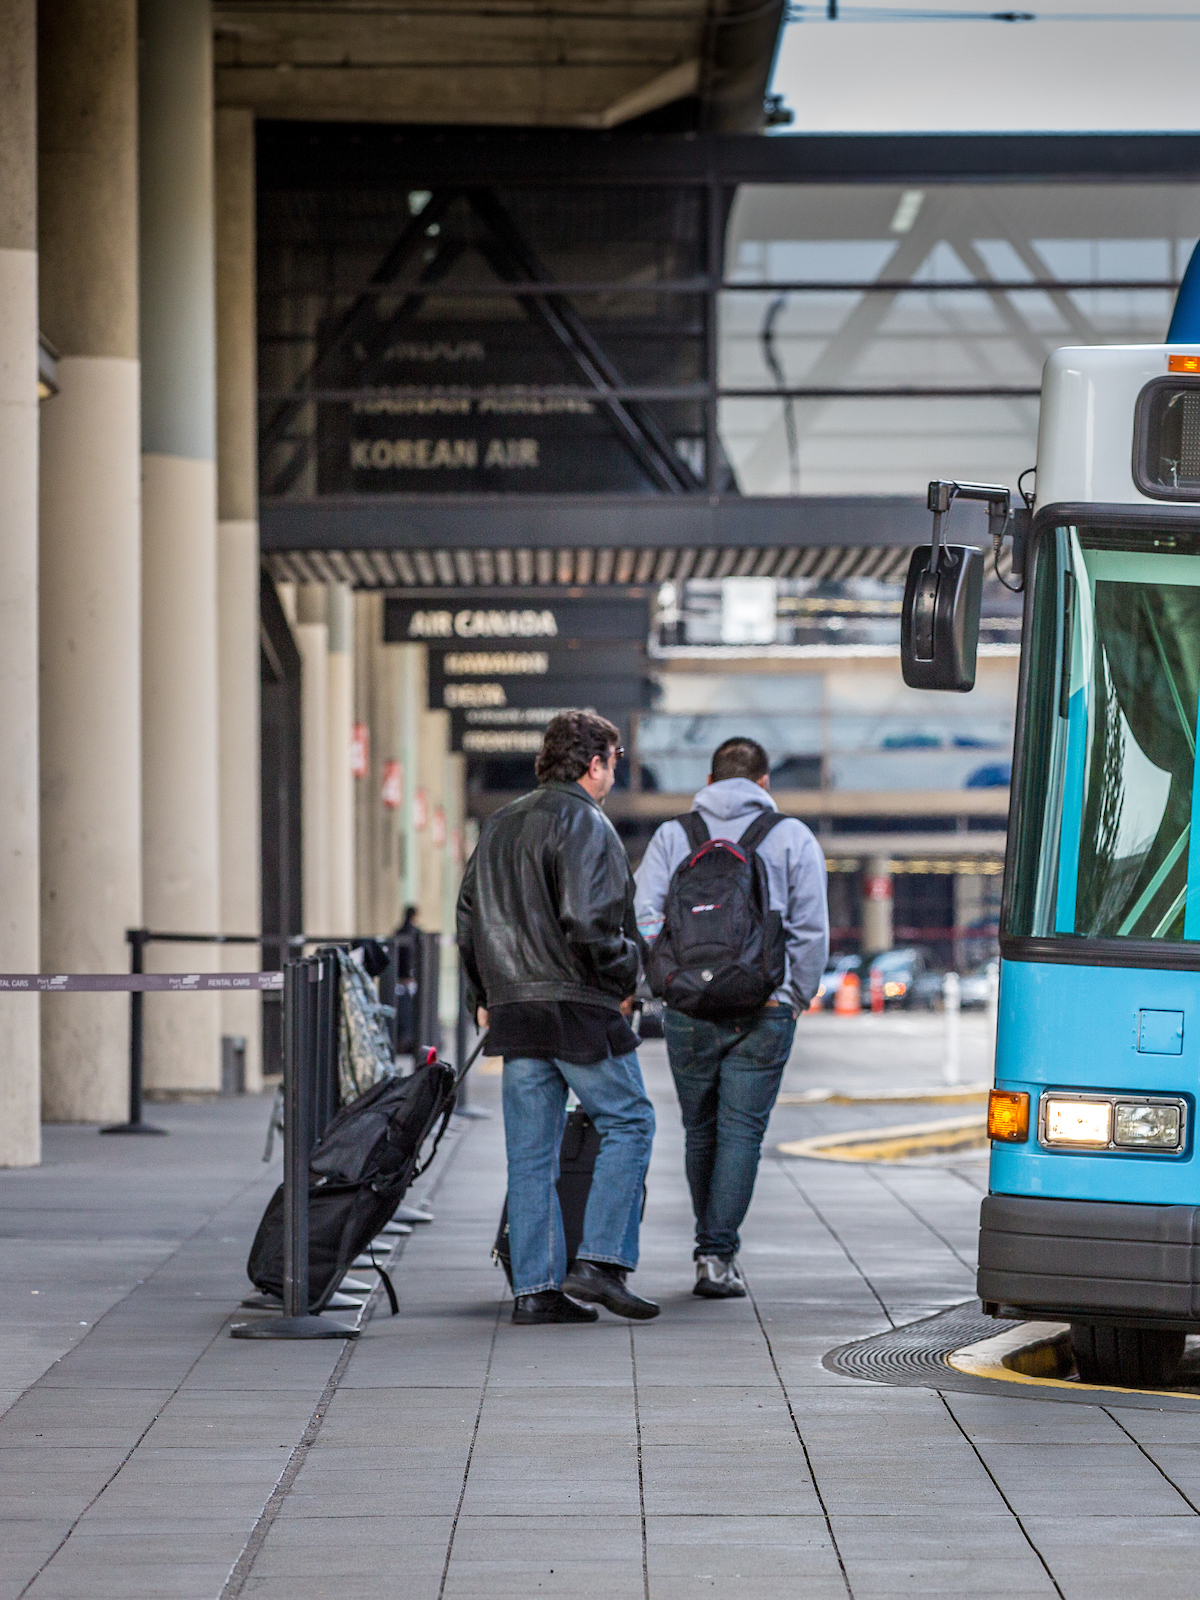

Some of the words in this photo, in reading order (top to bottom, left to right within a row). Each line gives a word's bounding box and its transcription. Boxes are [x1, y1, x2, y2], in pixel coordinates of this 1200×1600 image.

[351, 438, 477, 470] KOREAN
[484, 438, 539, 469] AIR
[408, 610, 453, 638] AIR
[454, 610, 559, 638] CANADA
[208, 979, 232, 987] RENTAL
[233, 978, 251, 986] CARS
